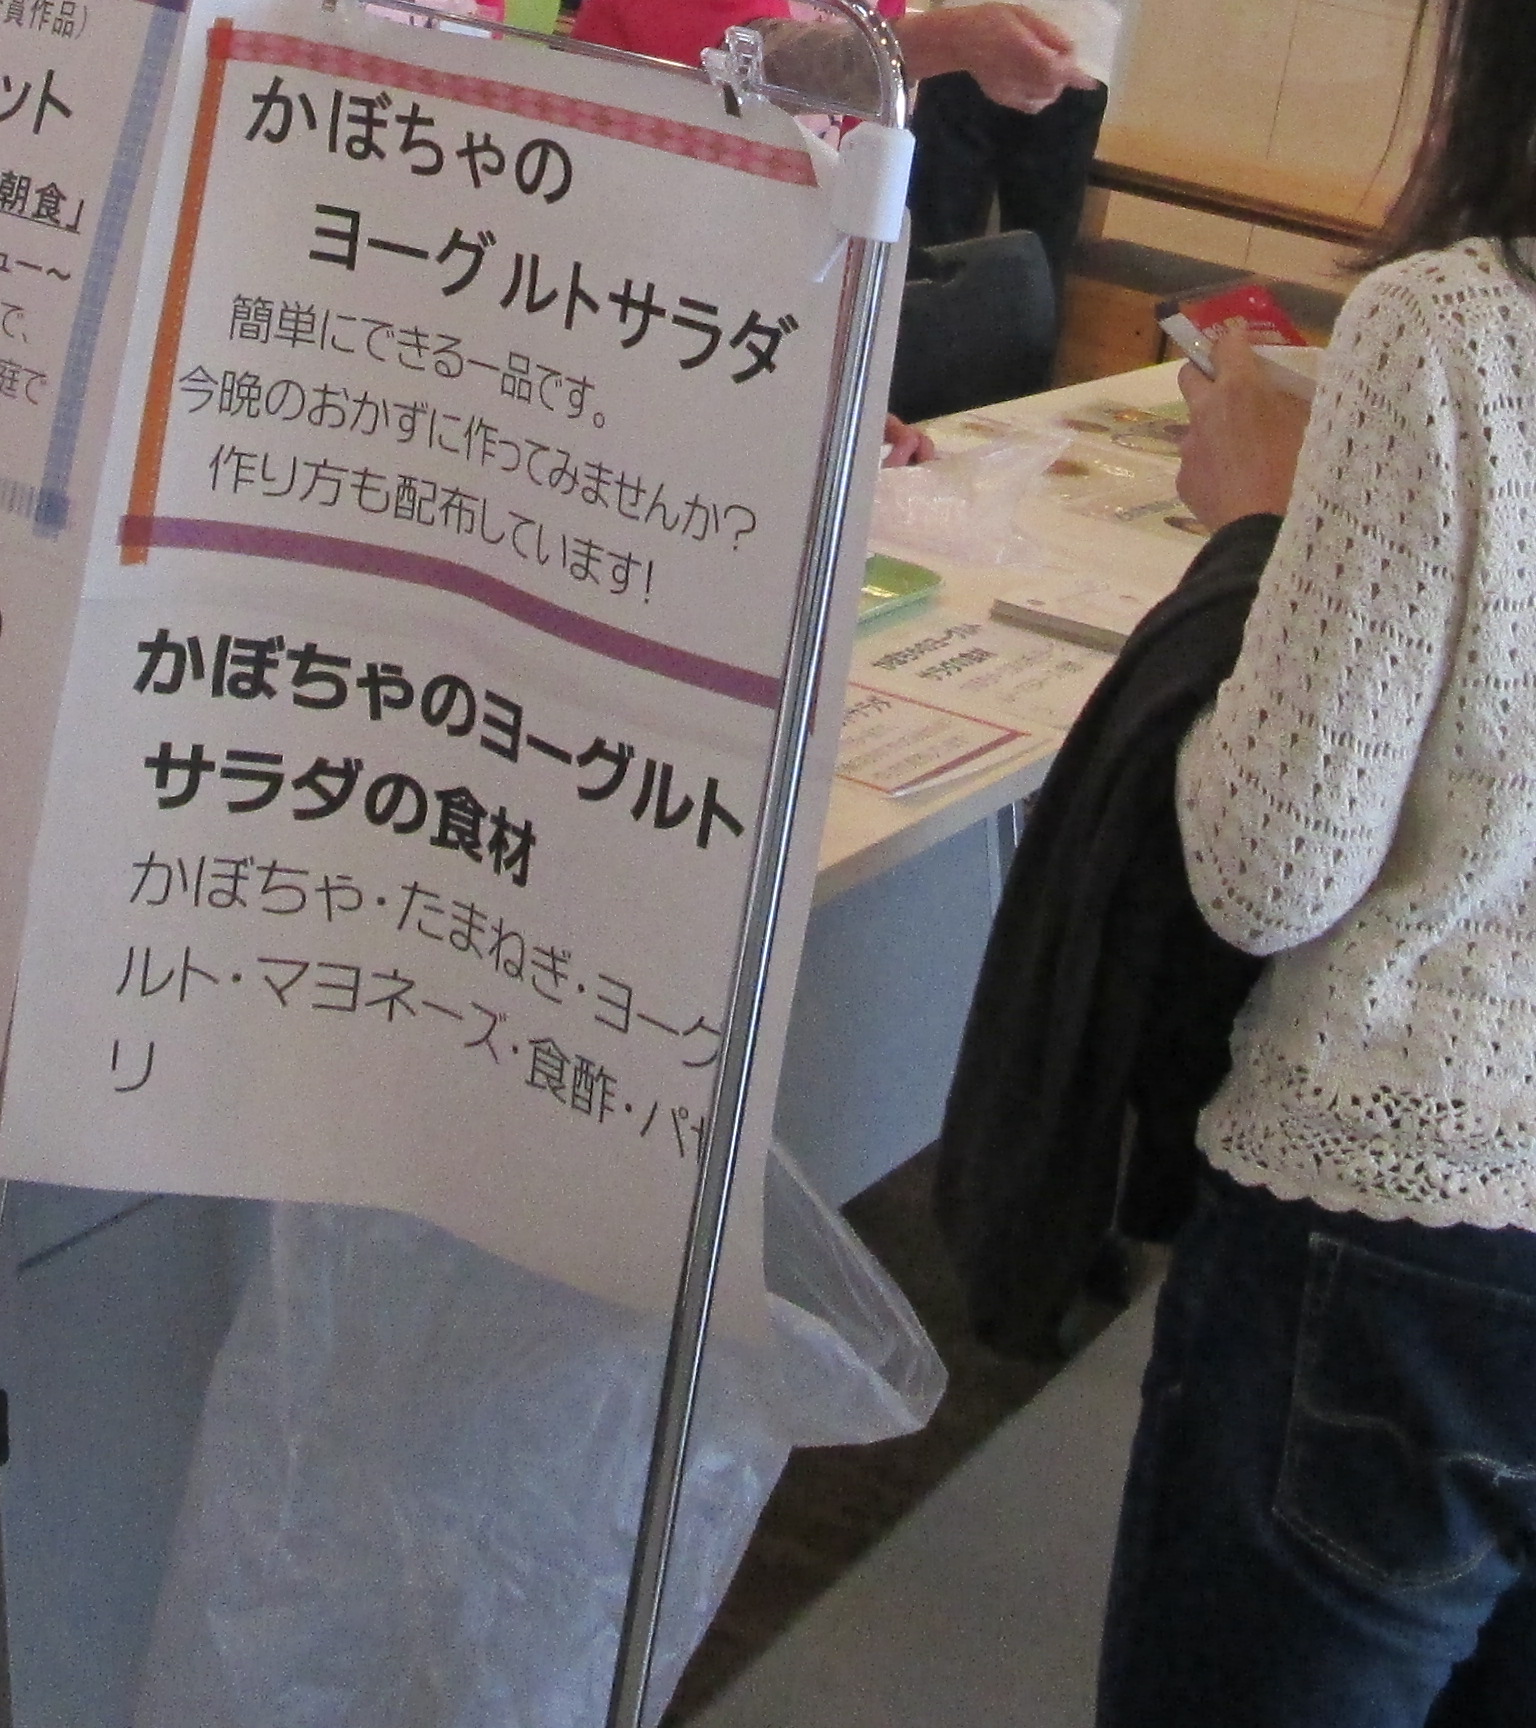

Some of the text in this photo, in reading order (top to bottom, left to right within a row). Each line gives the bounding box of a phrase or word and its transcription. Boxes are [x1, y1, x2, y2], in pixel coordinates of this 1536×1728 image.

[245, 76, 574, 205] かぼちゃの
[228, 294, 607, 430] 簡単にできる一品です。
[309, 203, 800, 385] ヨーグルトサラダ
[178, 364, 758, 551] 今晩のおかずに作ってみませんか？
[209, 445, 654, 605] 作り方も配布しています！
[133, 628, 745, 850] かぼちゃのヨーグルト
[145, 741, 537, 888] サラダの食材
